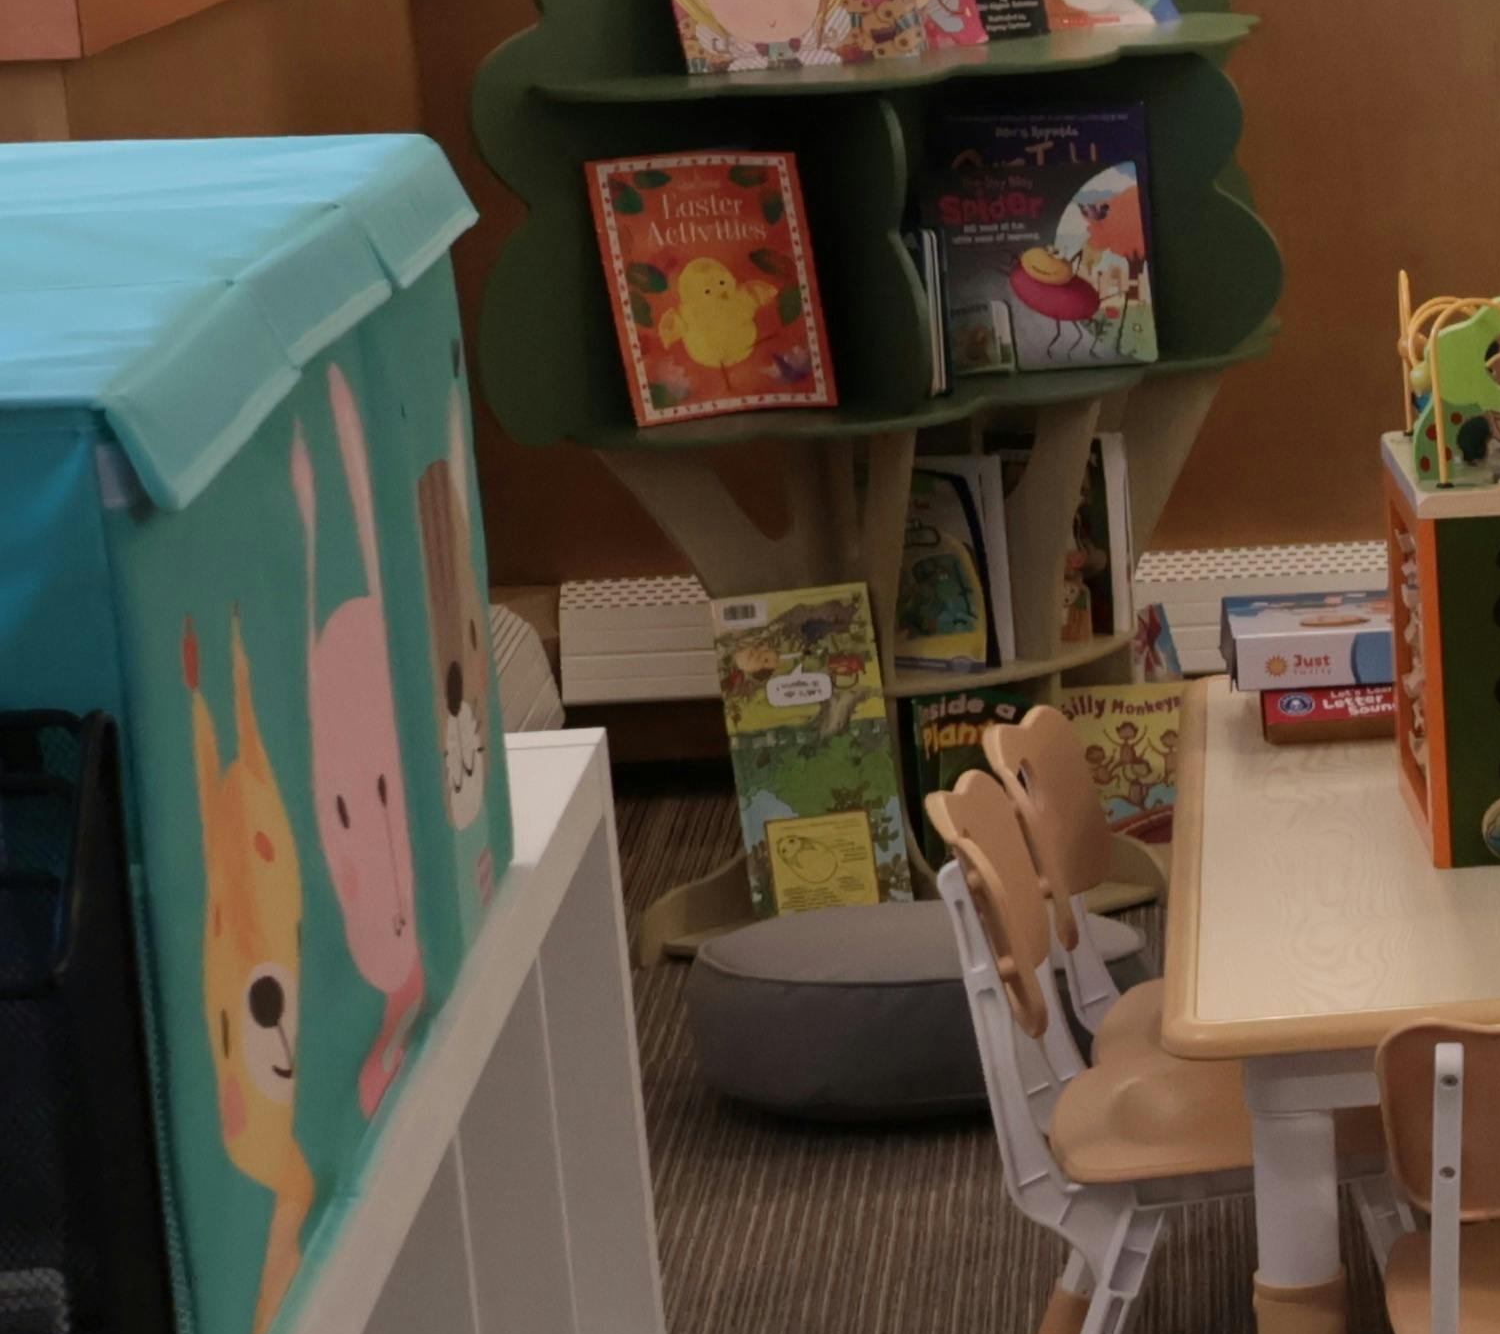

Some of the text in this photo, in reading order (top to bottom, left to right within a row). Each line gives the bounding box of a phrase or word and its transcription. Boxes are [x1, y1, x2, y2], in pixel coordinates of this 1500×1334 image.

[661, 193, 743, 220] Easter
[648, 217, 768, 248] Activities
[1294, 653, 1331, 667] Just
[1322, 694, 1383, 710] Letter
